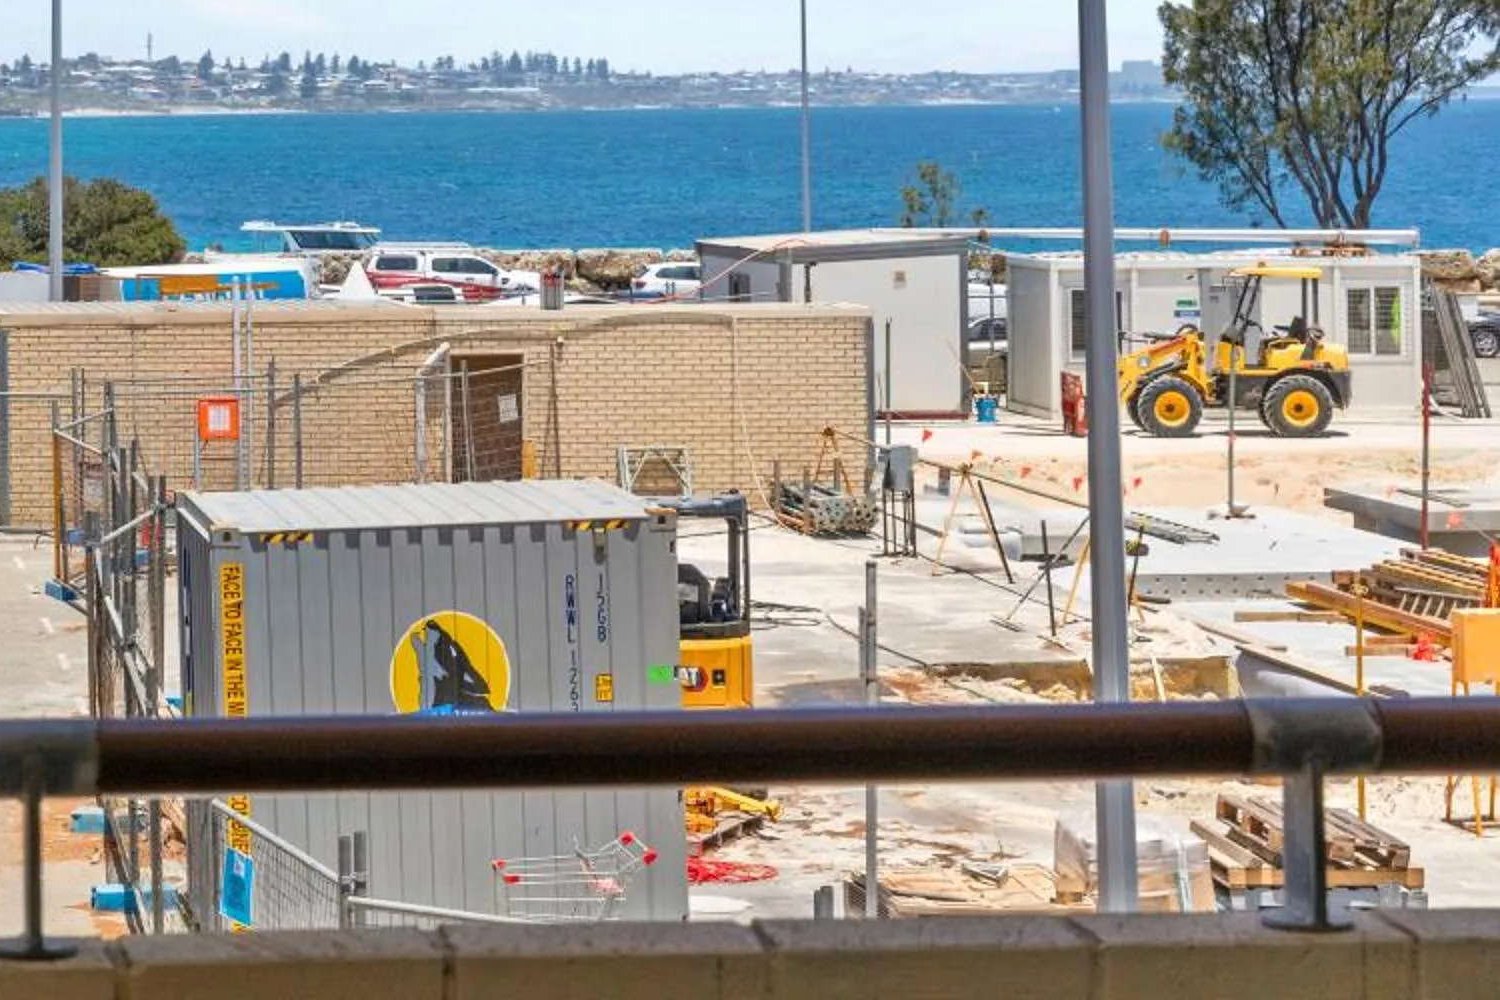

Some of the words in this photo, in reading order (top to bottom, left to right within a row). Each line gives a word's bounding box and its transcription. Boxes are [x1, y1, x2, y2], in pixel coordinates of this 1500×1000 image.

[223, 566, 241, 599] FACE
[225, 601, 242, 619] TO
[226, 623, 243, 655] FACE
[228, 659, 243, 671] IN
[228, 674, 244, 698] THE
